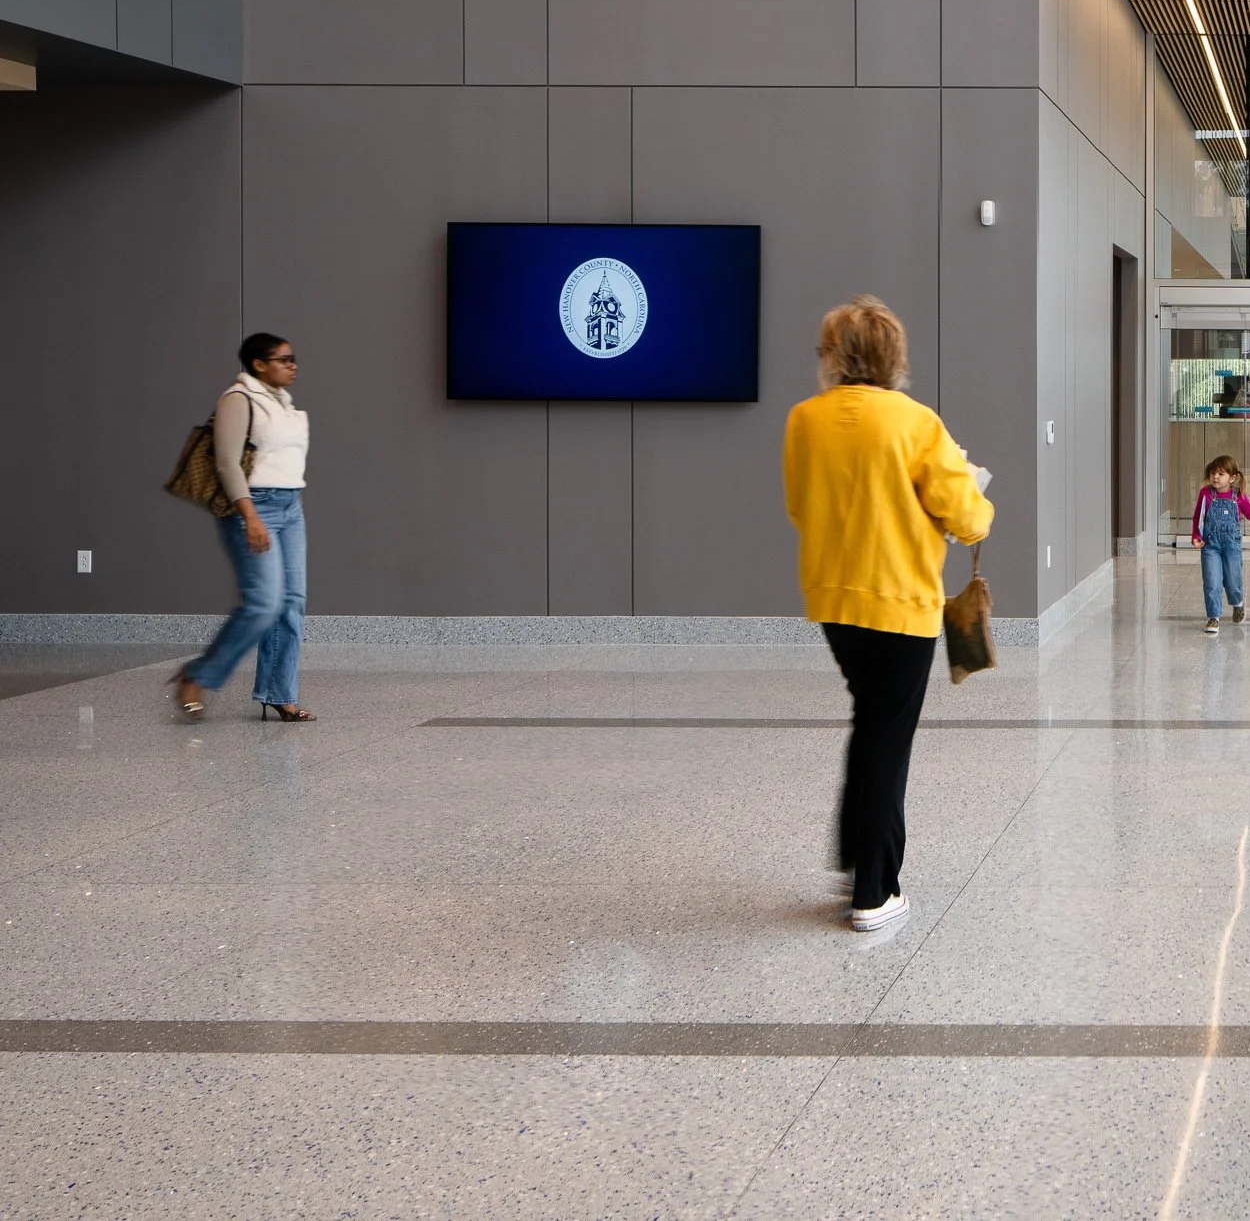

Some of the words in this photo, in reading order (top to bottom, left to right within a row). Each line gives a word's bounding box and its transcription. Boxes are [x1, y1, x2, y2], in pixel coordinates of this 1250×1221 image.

[579, 260, 614, 275] COUNTY
[619, 266, 641, 291] NORTH
[562, 273, 580, 311] HANOVER
[563, 315, 574, 333] NEW
[633, 292, 646, 334] CAROLINA
